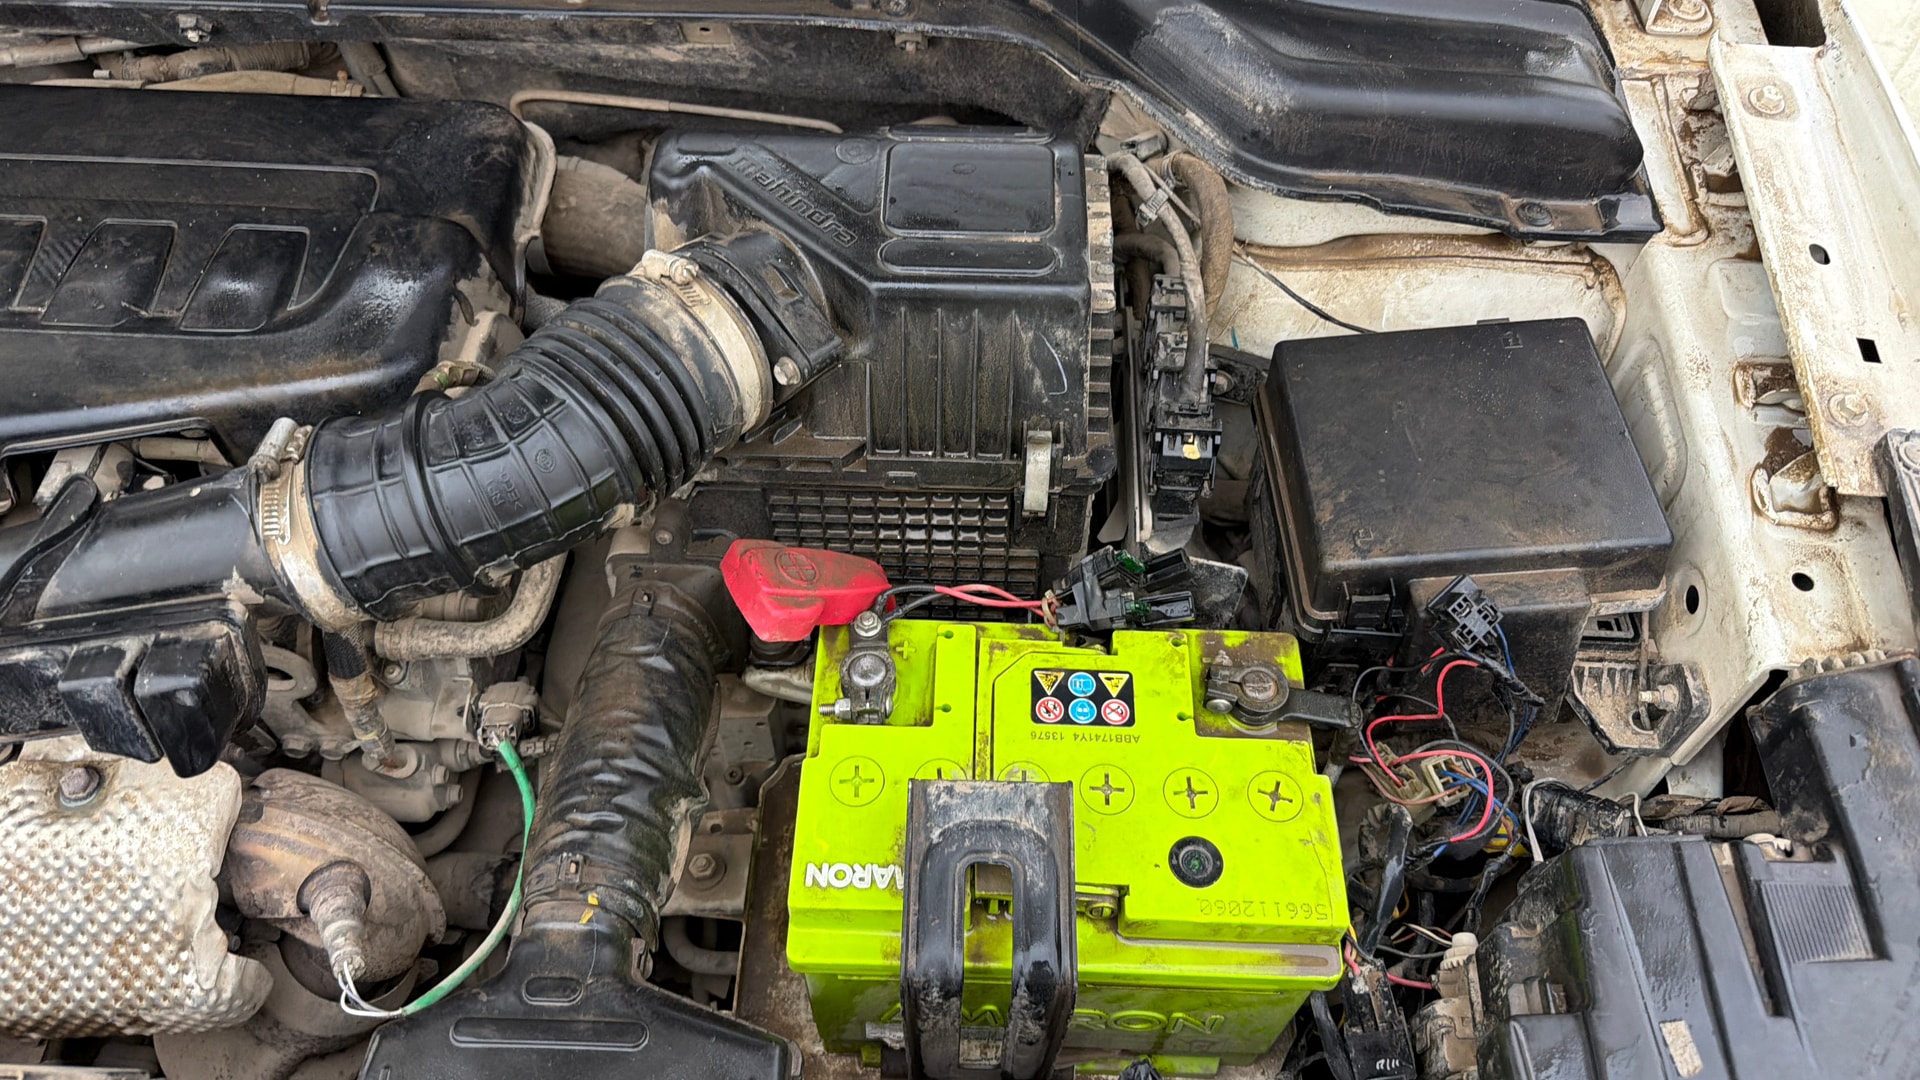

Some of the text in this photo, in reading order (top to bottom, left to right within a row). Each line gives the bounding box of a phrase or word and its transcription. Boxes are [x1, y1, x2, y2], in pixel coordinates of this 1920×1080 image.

[1030, 730, 1141, 744] ABB1741Y4 13576
[805, 863, 904, 890] ARON
[880, 1001, 1225, 1035] MRON
